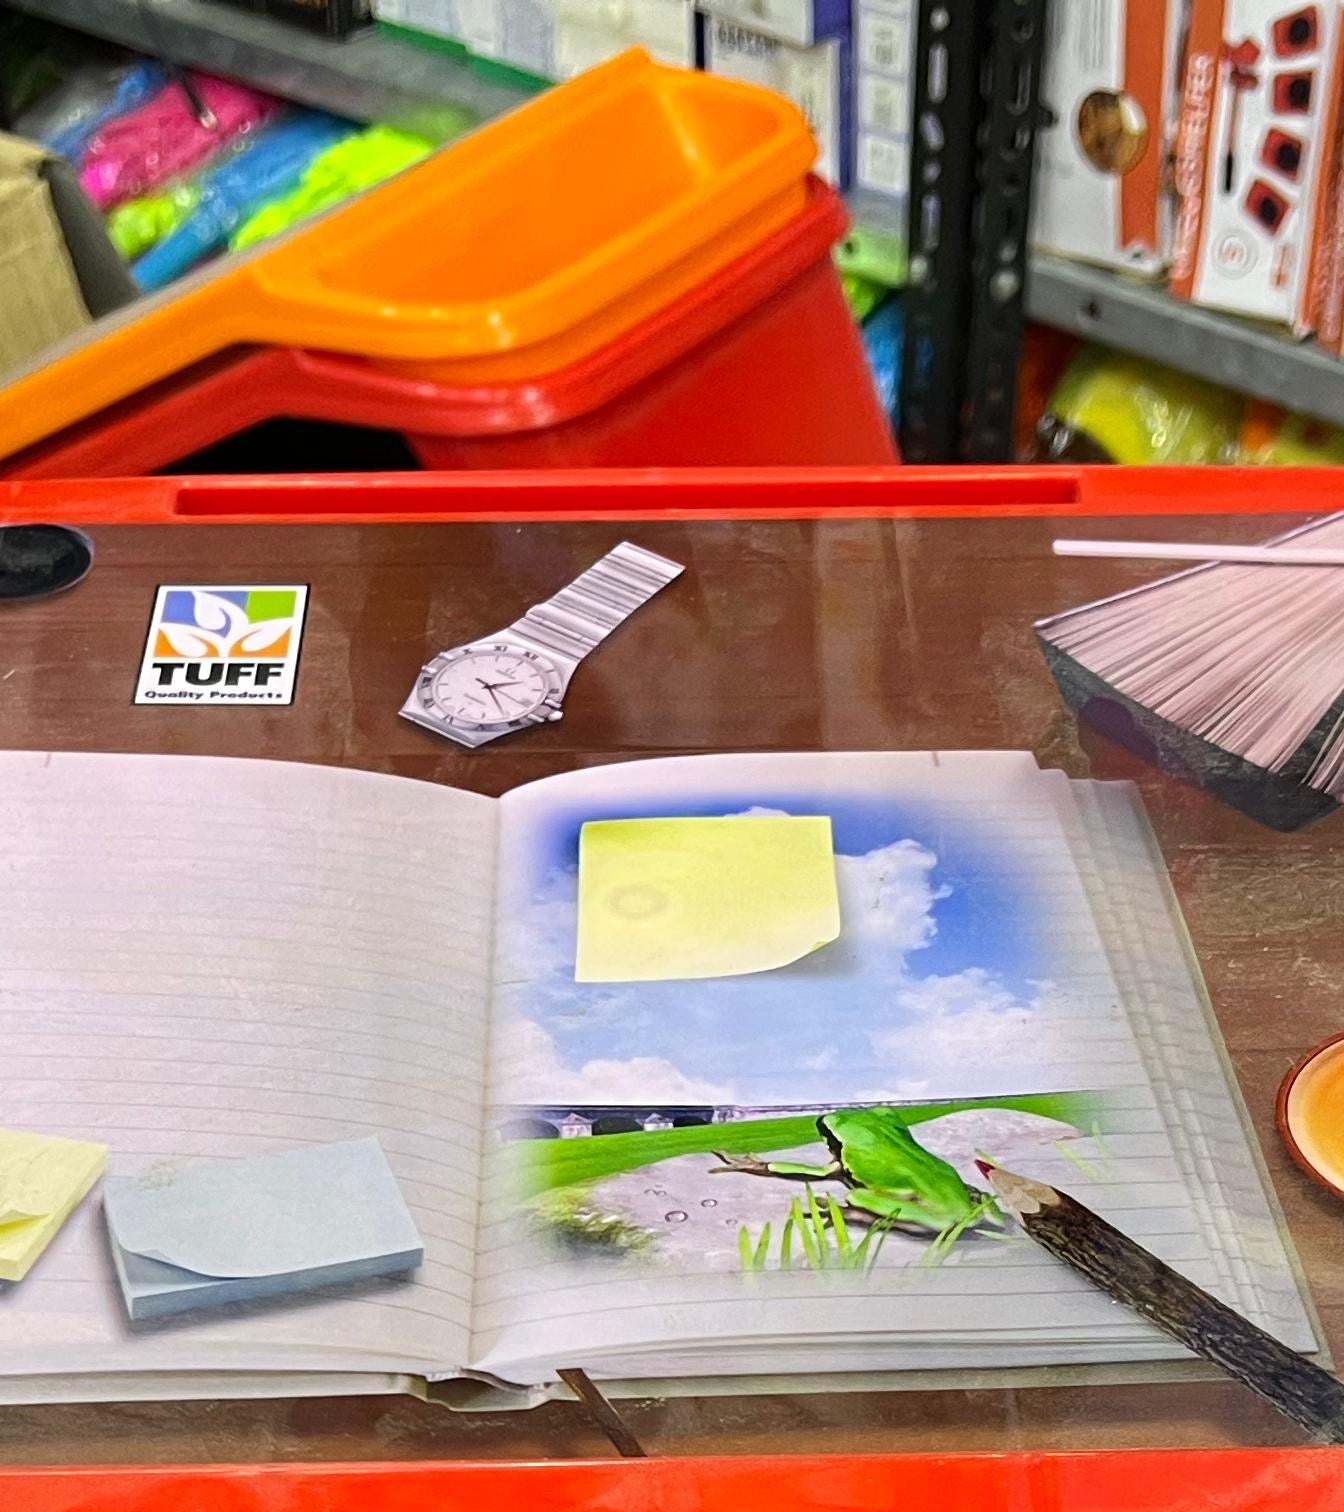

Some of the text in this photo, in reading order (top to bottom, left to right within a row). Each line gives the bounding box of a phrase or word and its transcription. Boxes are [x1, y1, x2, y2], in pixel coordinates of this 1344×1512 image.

[152, 662, 285, 686] TUFF
[144, 690, 283, 700] Quality Products
